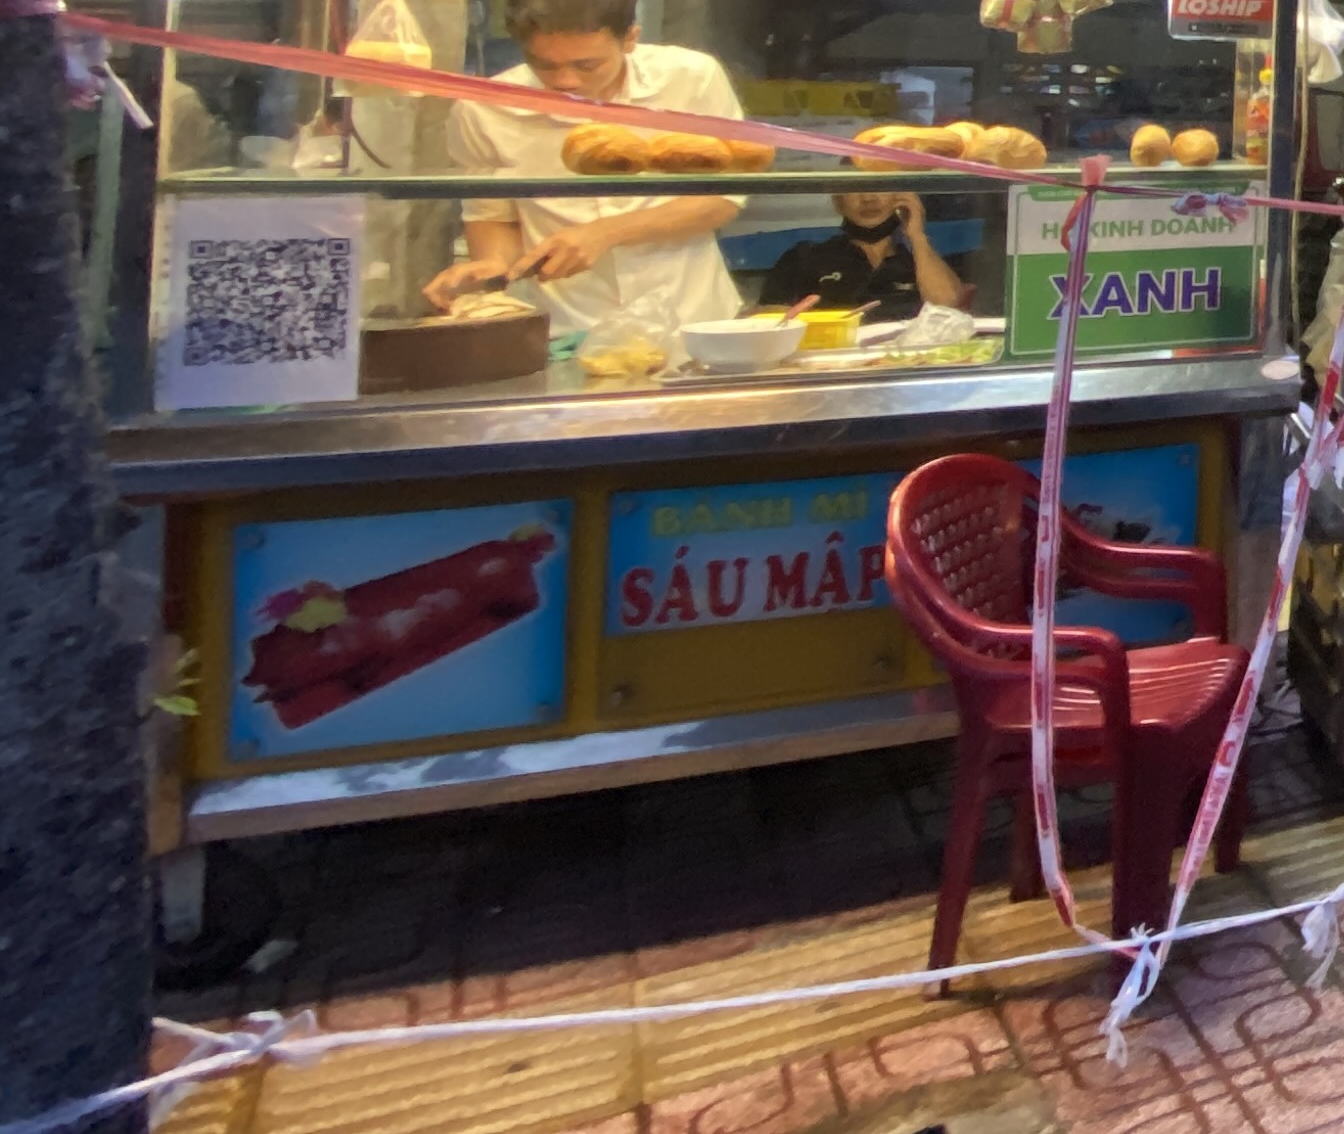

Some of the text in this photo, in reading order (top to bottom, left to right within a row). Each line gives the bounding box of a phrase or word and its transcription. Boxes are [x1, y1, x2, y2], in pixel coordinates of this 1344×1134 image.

[1150, 216, 1234, 237] DOANH
[1047, 266, 1222, 321] XANH
[620, 544, 750, 628] SÁU
